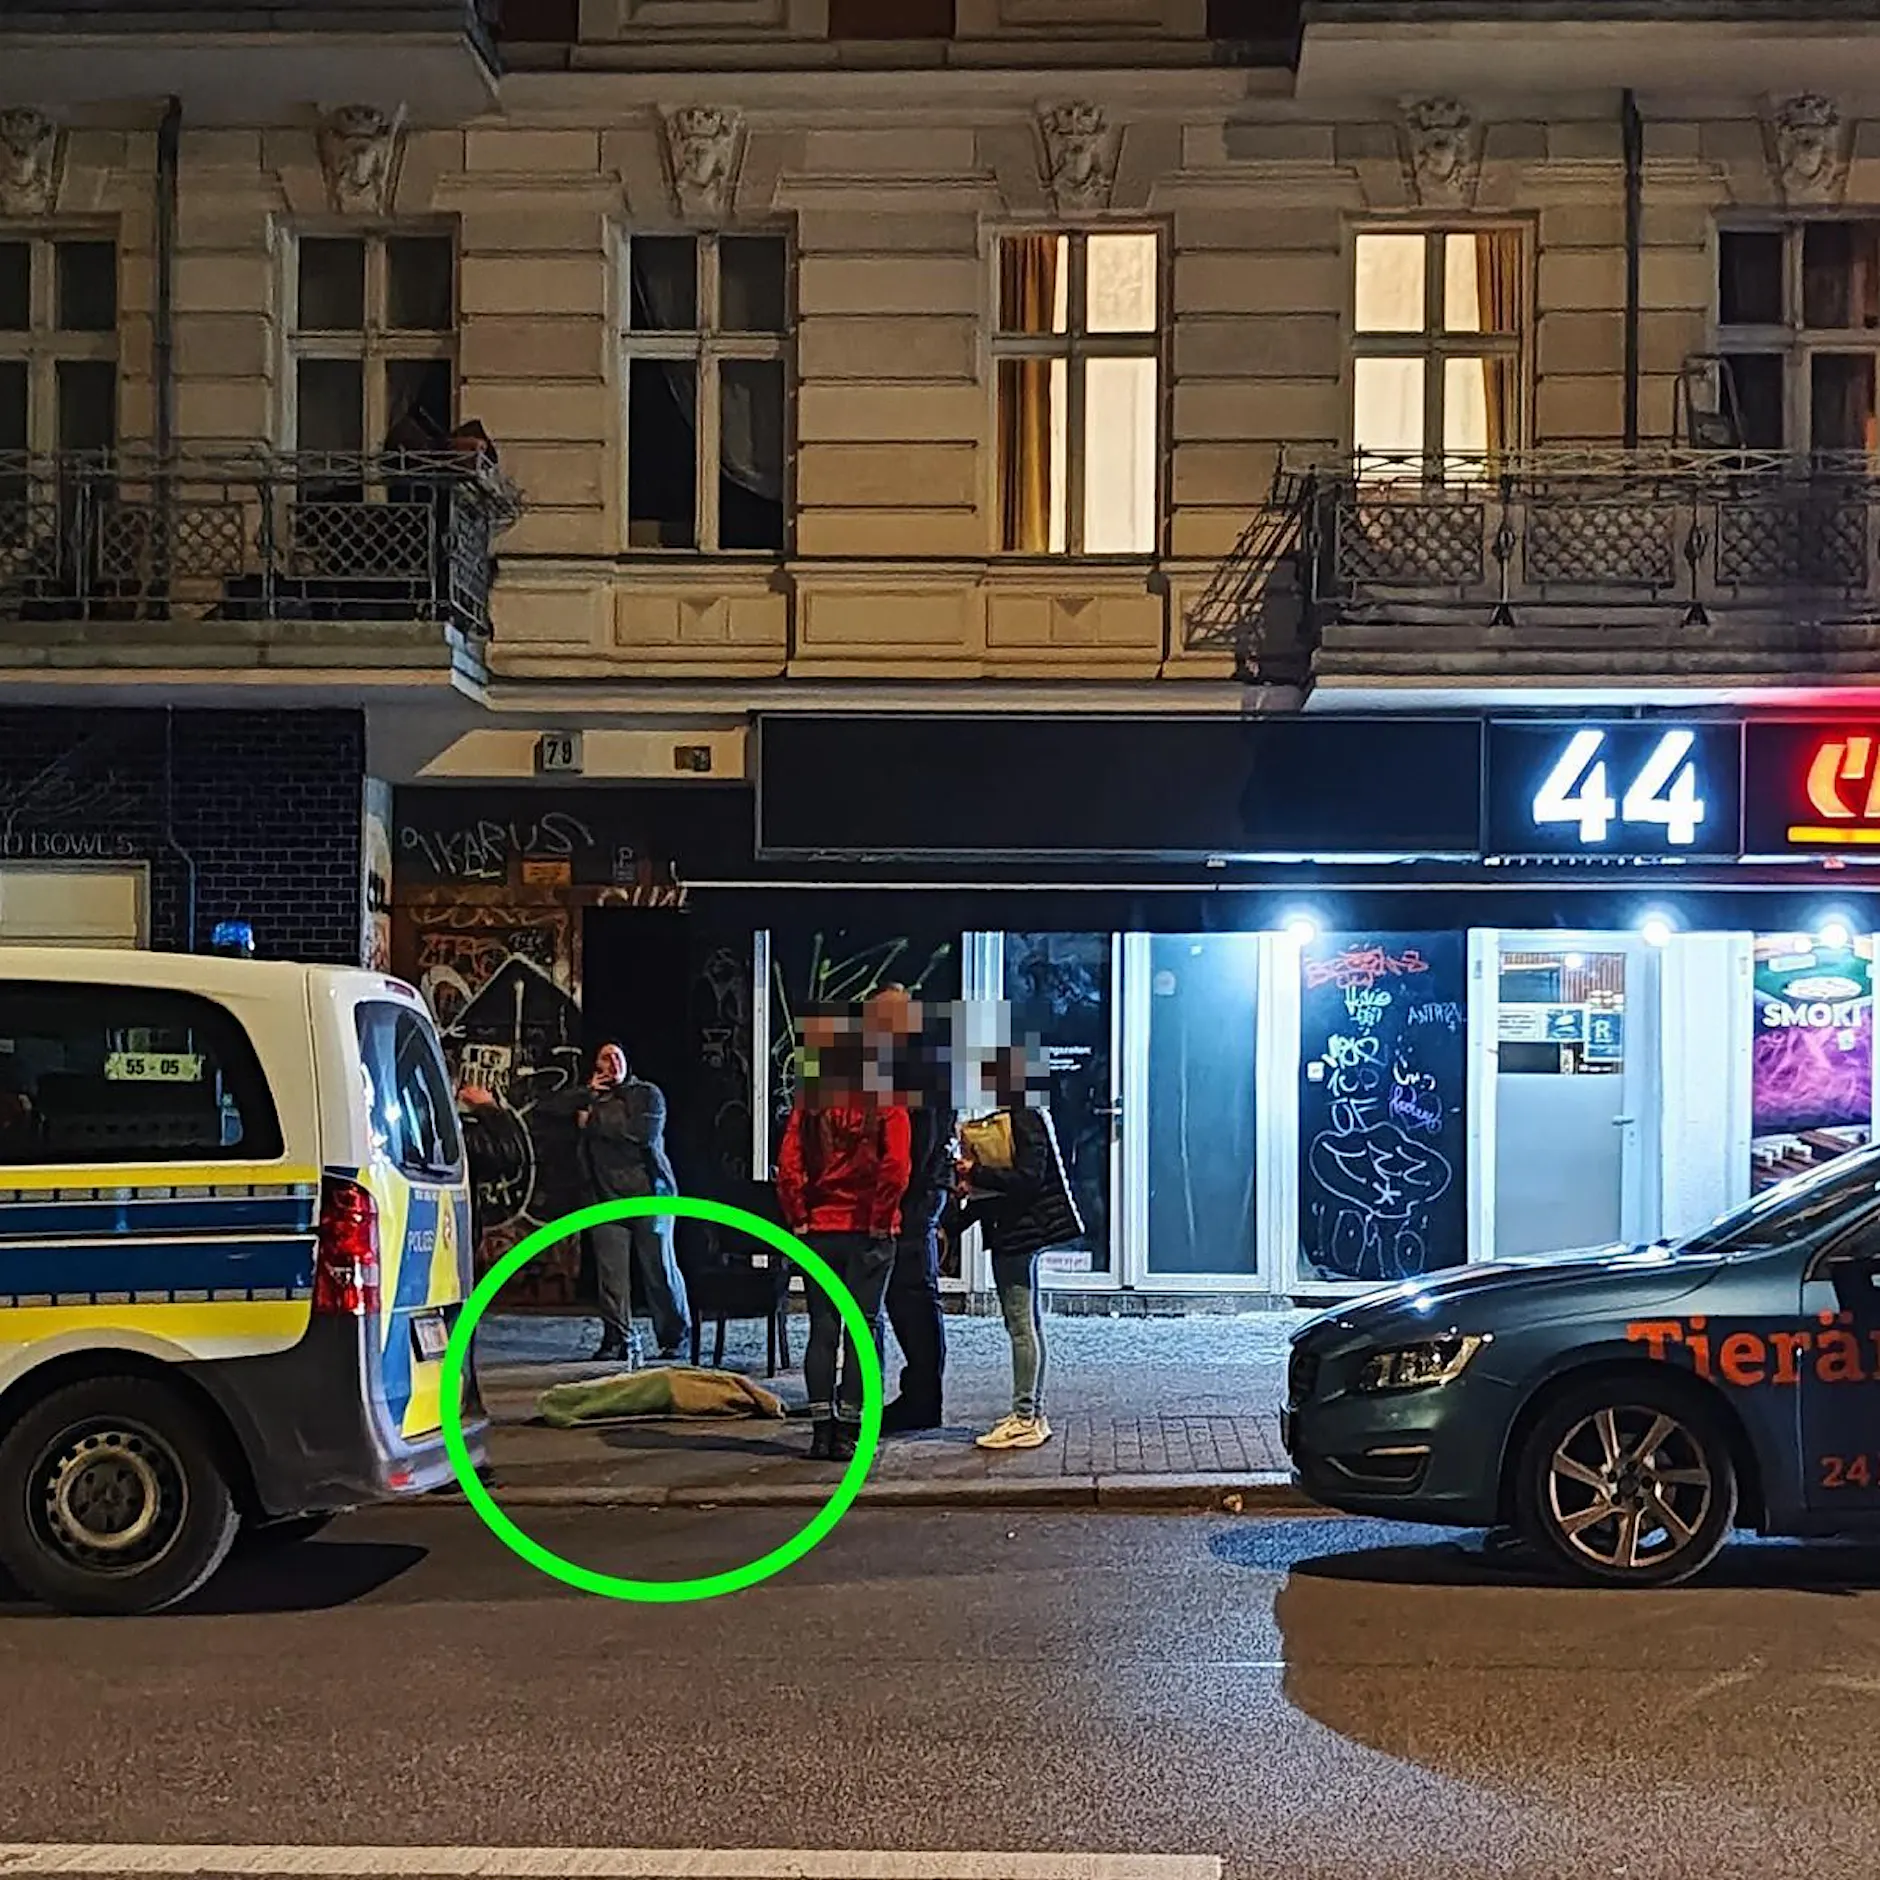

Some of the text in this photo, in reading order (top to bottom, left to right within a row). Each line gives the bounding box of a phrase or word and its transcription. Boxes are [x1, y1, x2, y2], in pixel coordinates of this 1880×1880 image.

[1532, 729, 1705, 845] 44
[0, 831, 134, 855] D BOWLS
[126, 1059, 145, 1075] 55
[160, 1059, 179, 1075] 05
